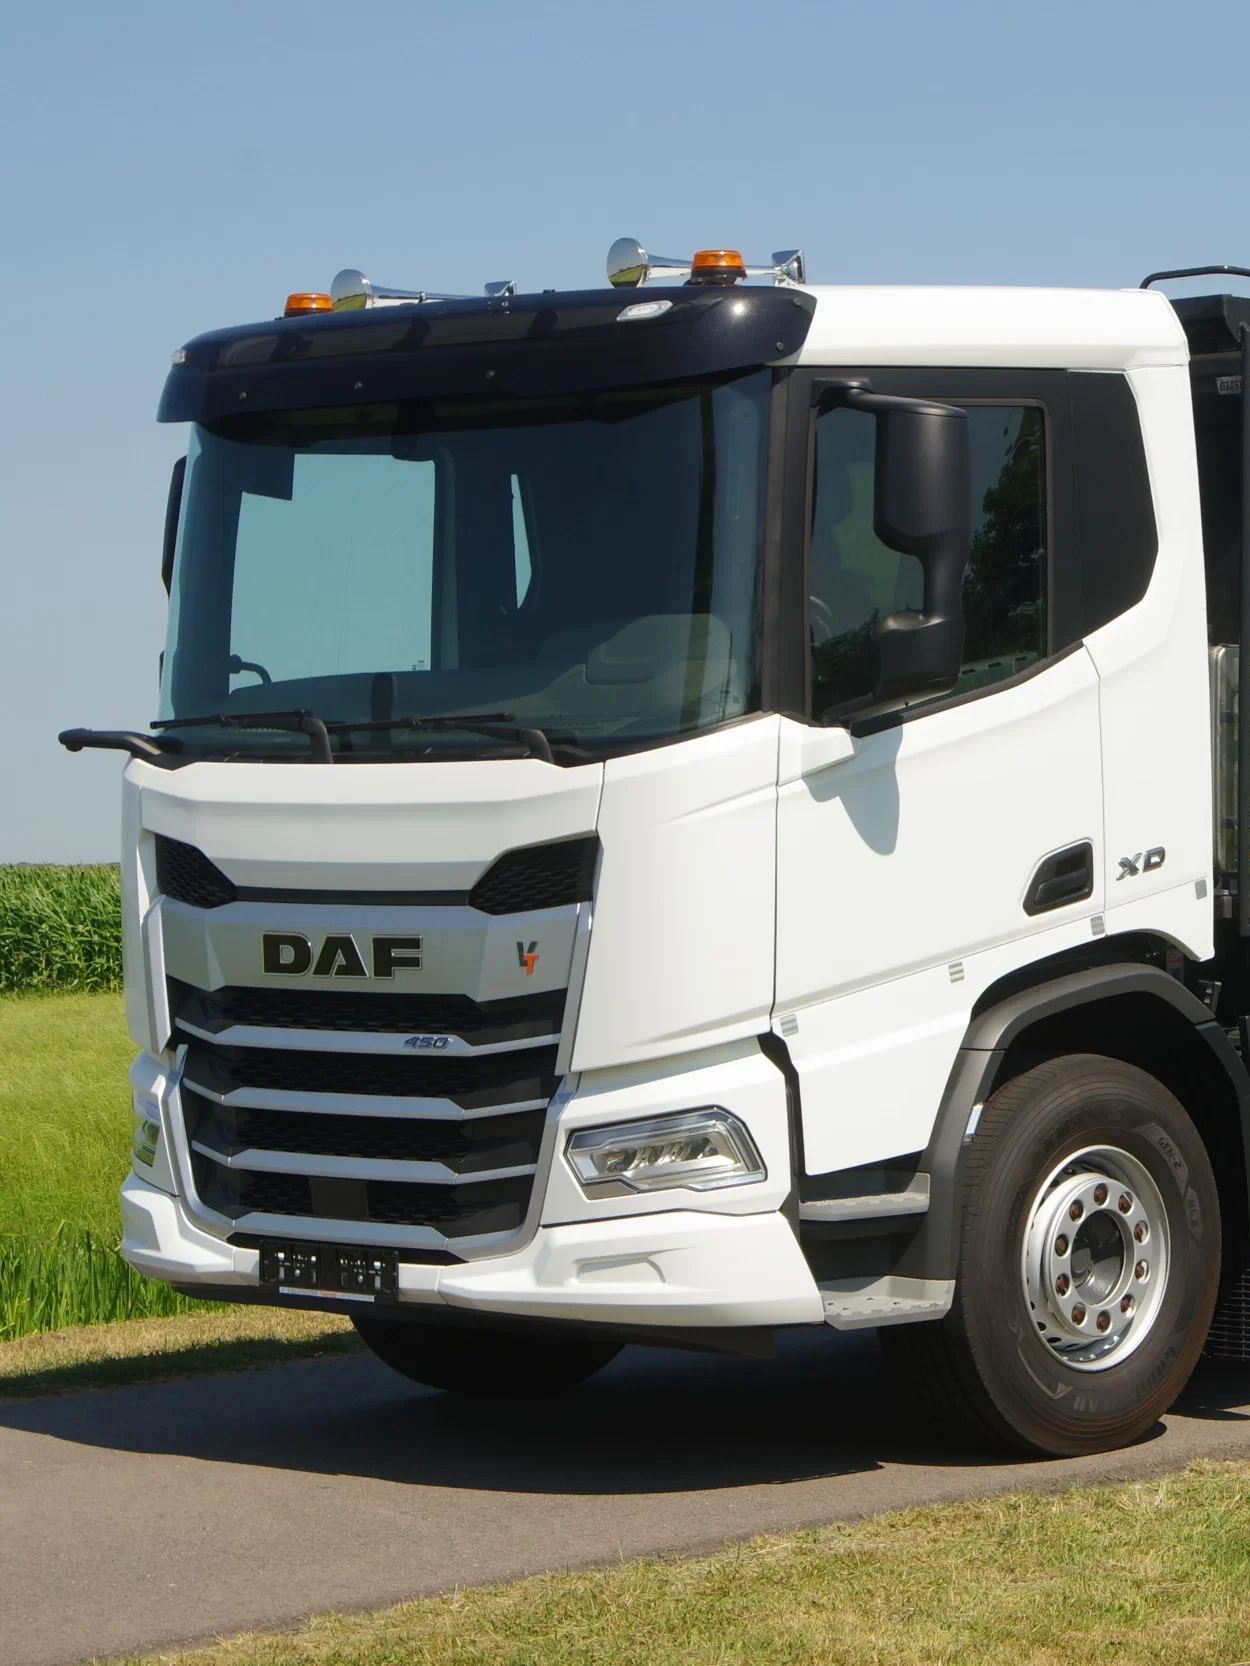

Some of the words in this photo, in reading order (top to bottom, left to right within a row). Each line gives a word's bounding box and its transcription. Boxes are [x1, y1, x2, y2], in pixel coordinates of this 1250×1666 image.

[1116, 846, 1166, 882] XD
[262, 931, 424, 980] DAF
[516, 940, 540, 976] VT
[403, 1035, 453, 1051] 450
[1157, 1136, 1182, 1170] GEN-2
